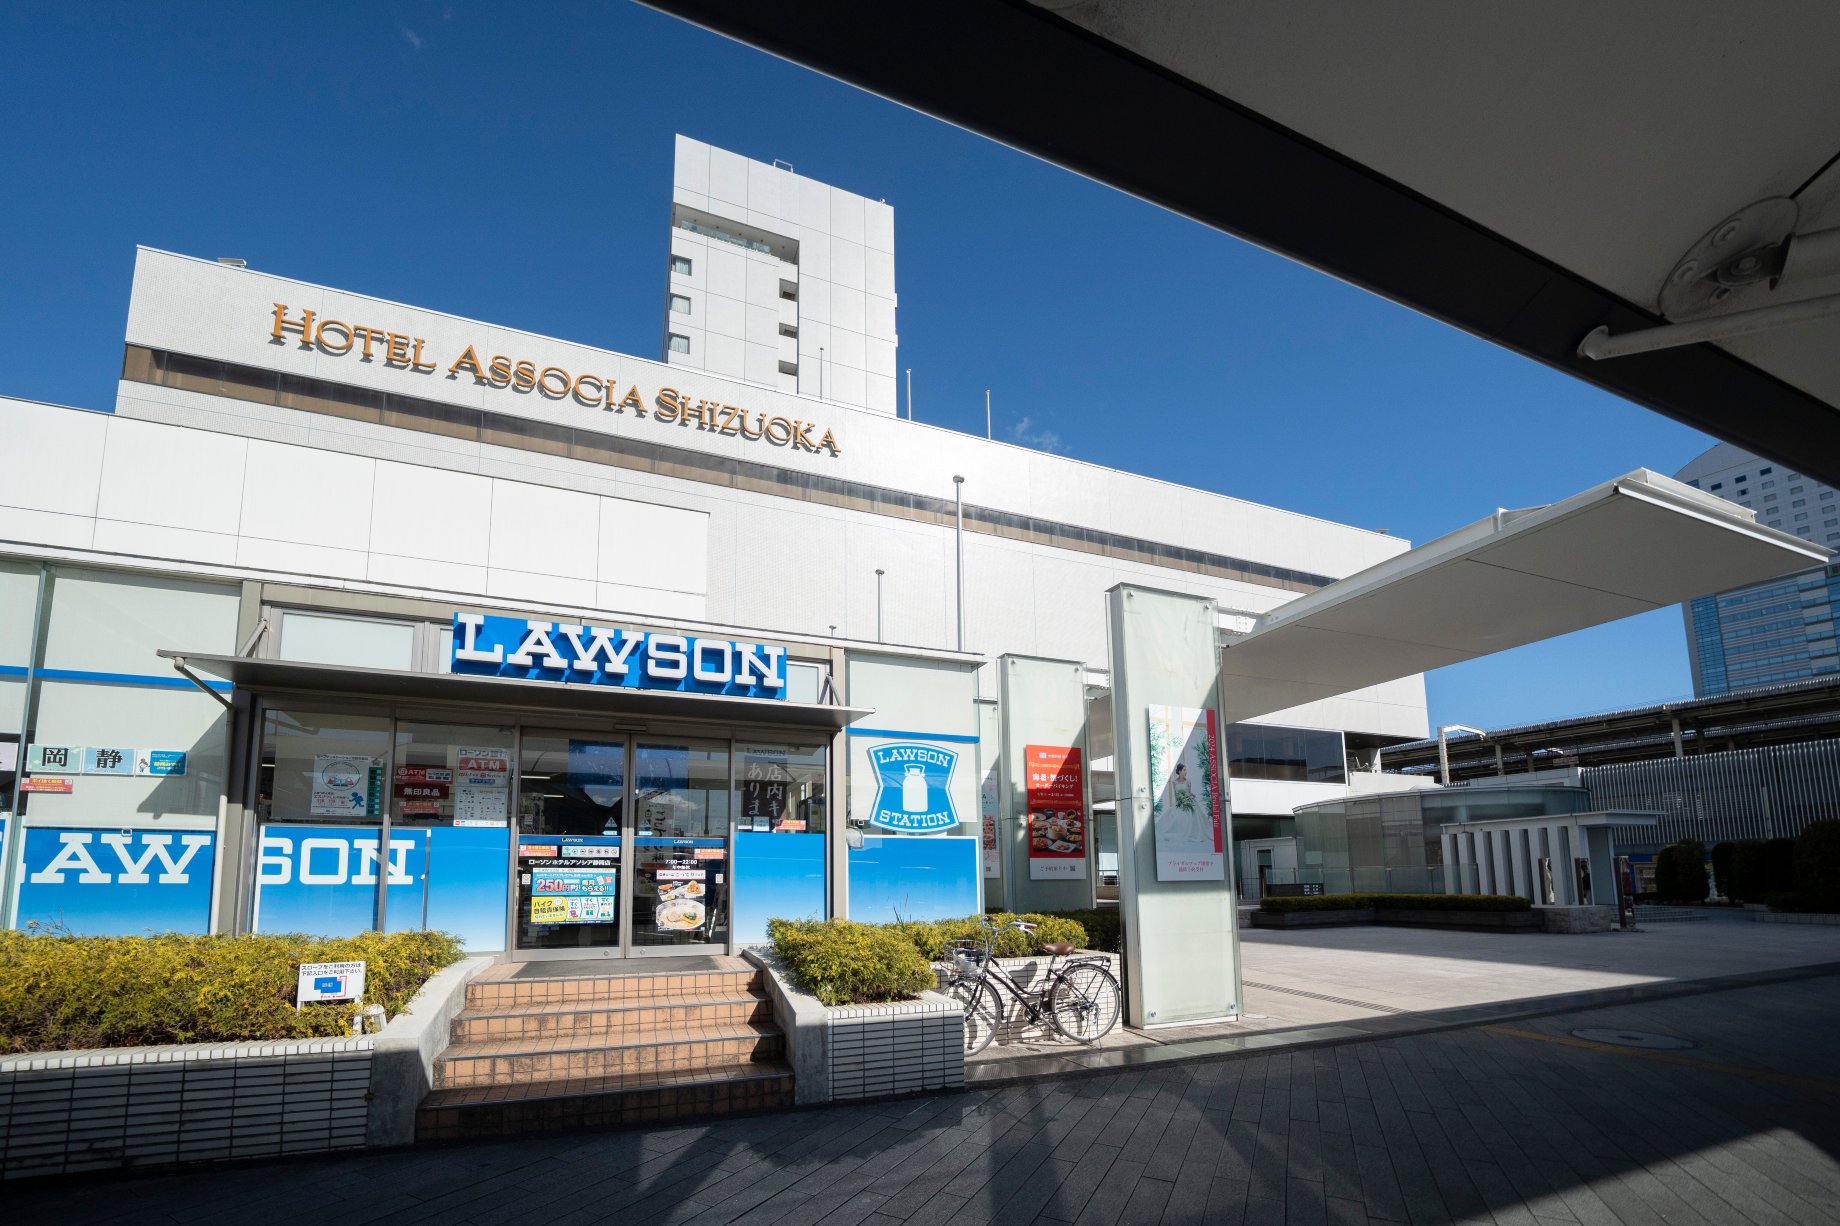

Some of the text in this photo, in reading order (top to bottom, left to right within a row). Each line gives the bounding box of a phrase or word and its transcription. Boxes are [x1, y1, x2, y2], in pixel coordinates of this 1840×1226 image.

[270, 302, 842, 454] HOTEL ASSOCIA SHIZUOKA
[455, 612, 785, 688] LAWSON
[42, 747, 122, 769] 岡 静
[467, 759, 500, 770] ATM
[877, 748, 951, 768] LAWSON
[404, 788, 440, 796] 無印良品
[880, 809, 951, 827] STATION
[20, 832, 212, 884] AW
